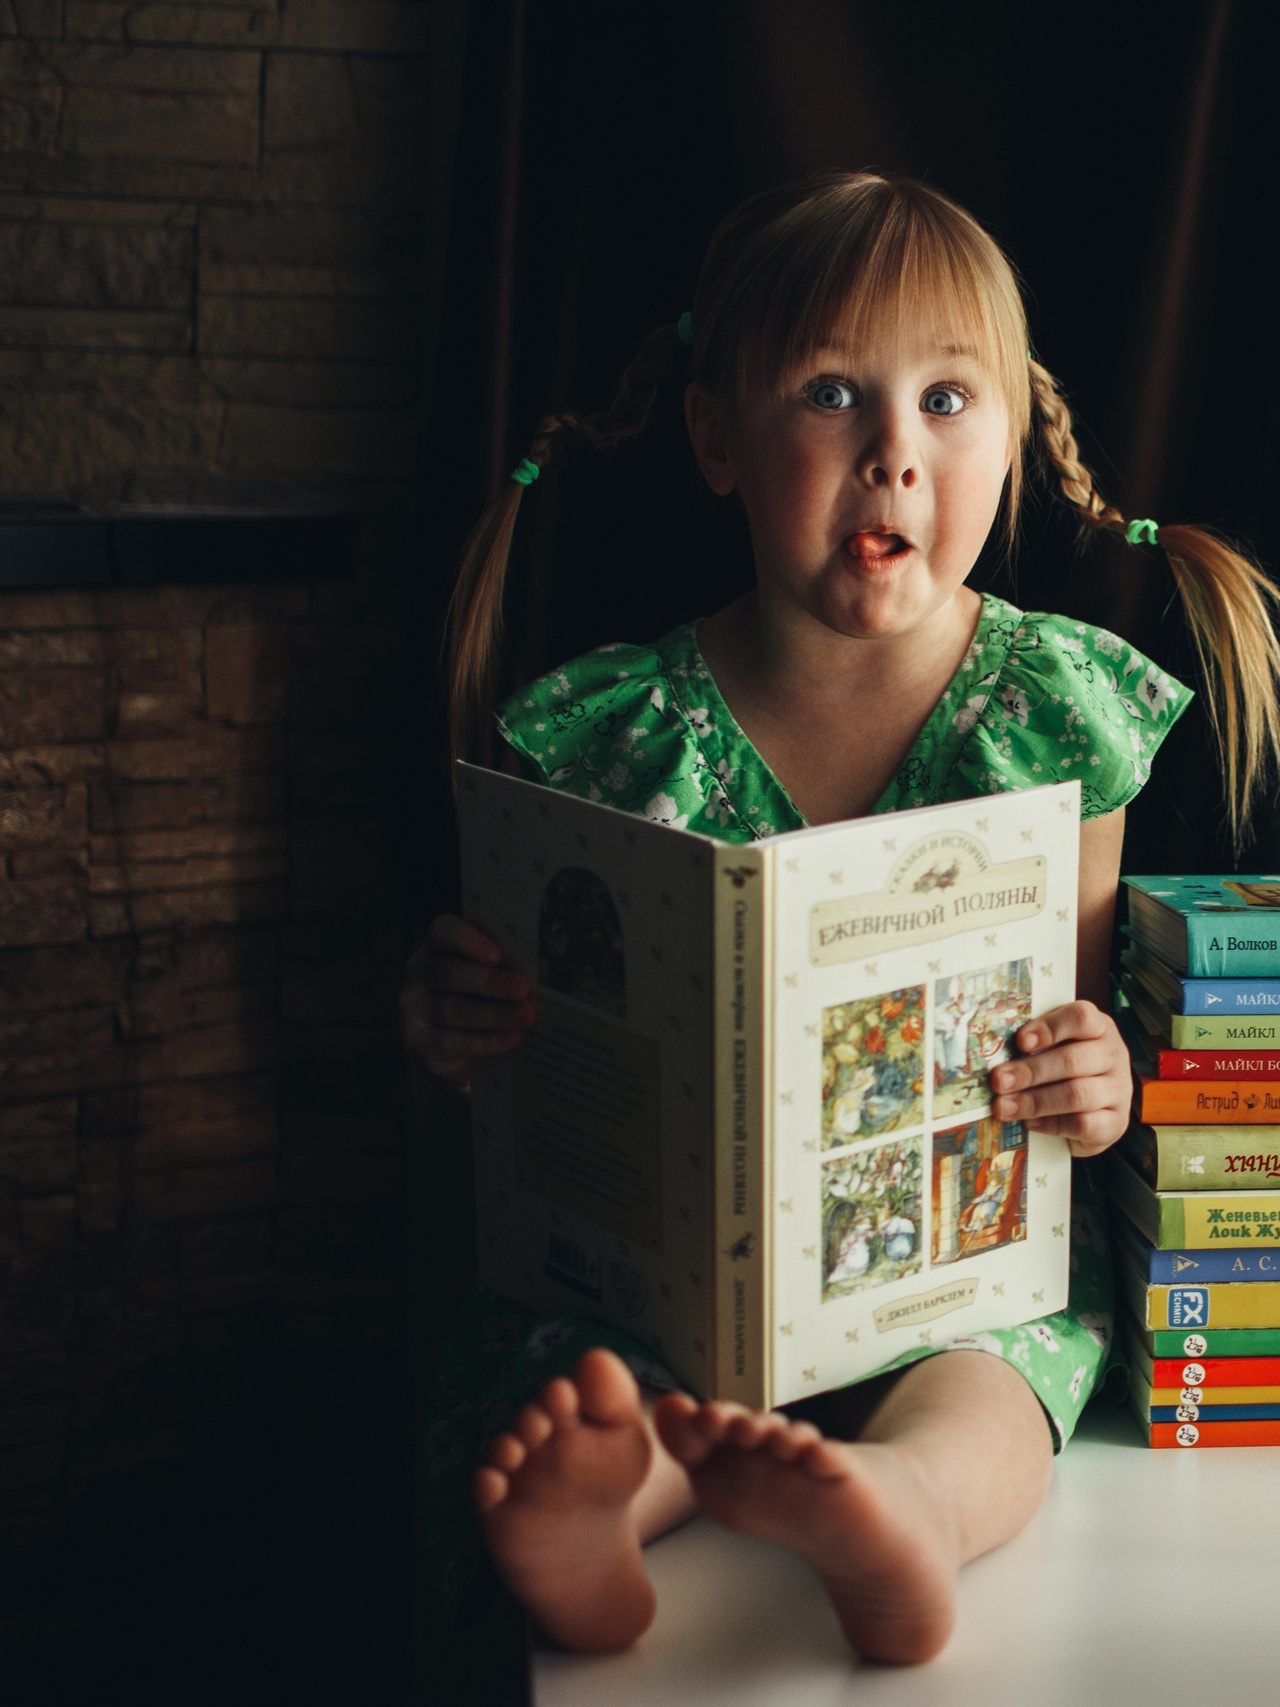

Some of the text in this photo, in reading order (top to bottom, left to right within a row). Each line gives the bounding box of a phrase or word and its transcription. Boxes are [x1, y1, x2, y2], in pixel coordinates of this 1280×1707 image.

[929, 839, 938, 850] И
[941, 837, 988, 872] ИСТОРИИ
[818, 886, 1038, 947] ЕЖЕВИЧНОЙ ПОЛЯНЫ
[1209, 937, 1278, 951] А. Волков
[1226, 1026, 1276, 1039] МАЙКЛ
[1214, 1058, 1264, 1072] МАЙКЛ
[1196, 1091, 1239, 1113] Астрид
[1209, 1225, 1251, 1238] Лоик
[1232, 1257, 1250, 1271] А.
[1259, 1256, 1277, 1271] С.
[886, 1288, 966, 1322] ДЖИЛЛ БАРКЛЕМ
[1173, 1291, 1182, 1325] SCHMID
[1183, 1291, 1204, 1324] FX
